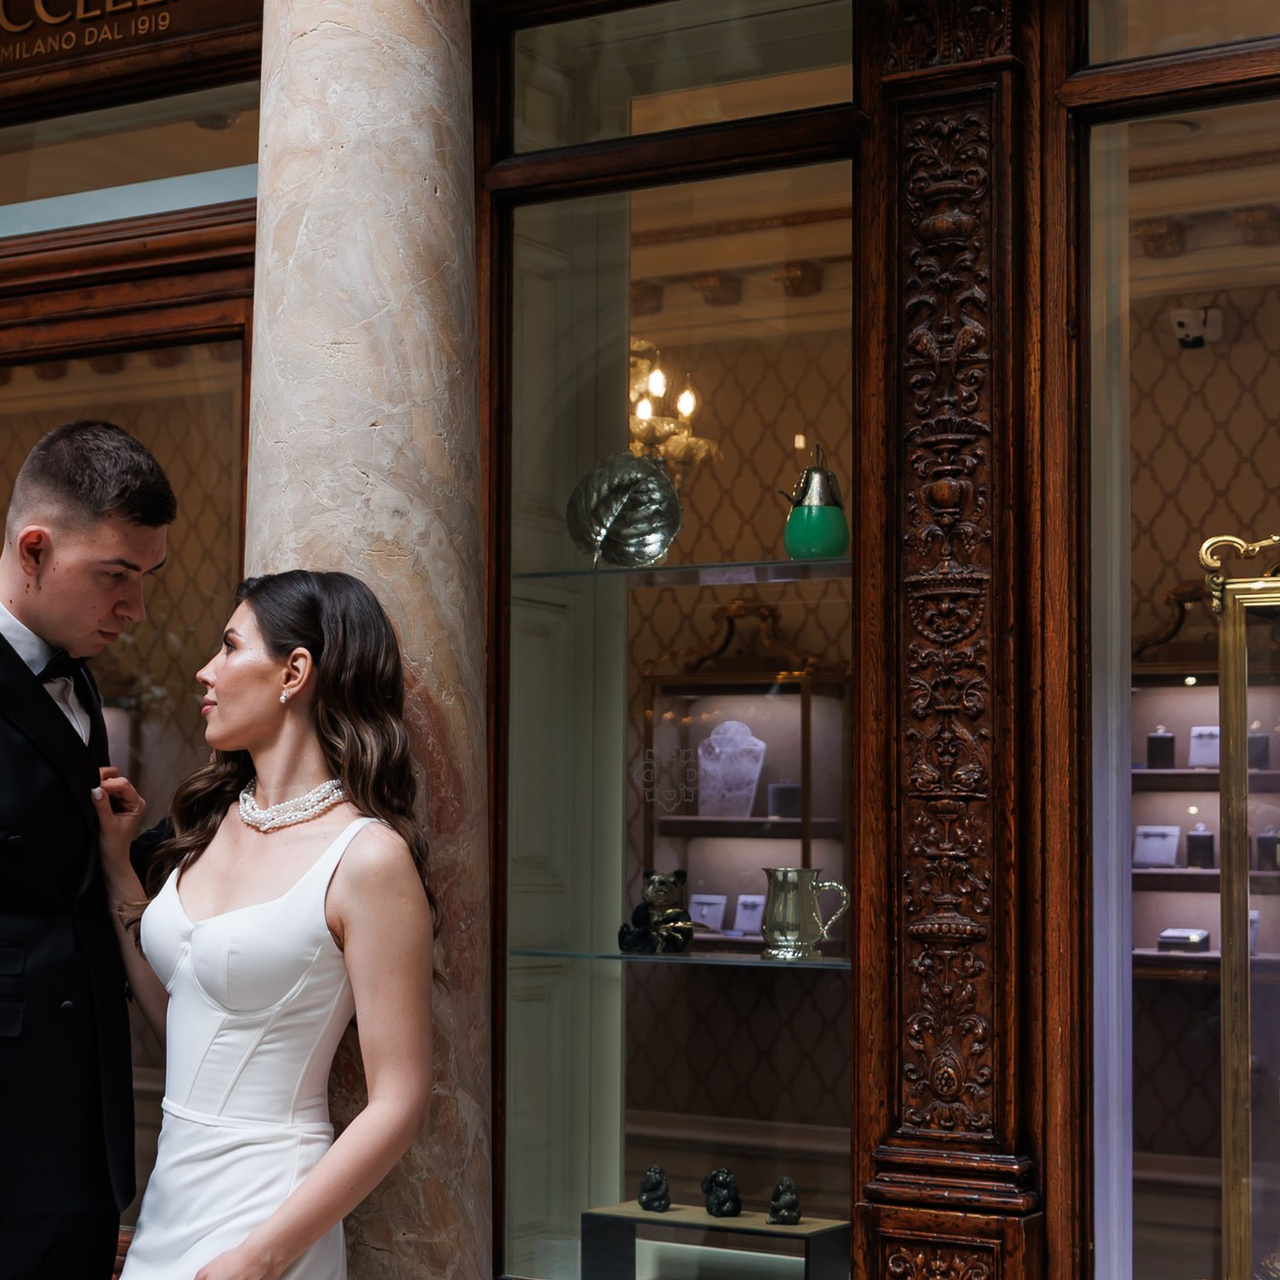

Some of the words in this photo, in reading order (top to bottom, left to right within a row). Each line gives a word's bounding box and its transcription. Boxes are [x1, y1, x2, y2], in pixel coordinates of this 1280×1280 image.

[0, 31, 77, 62] MILANO
[85, 22, 123, 46] DAL
[131, 11, 170, 36] 1919
